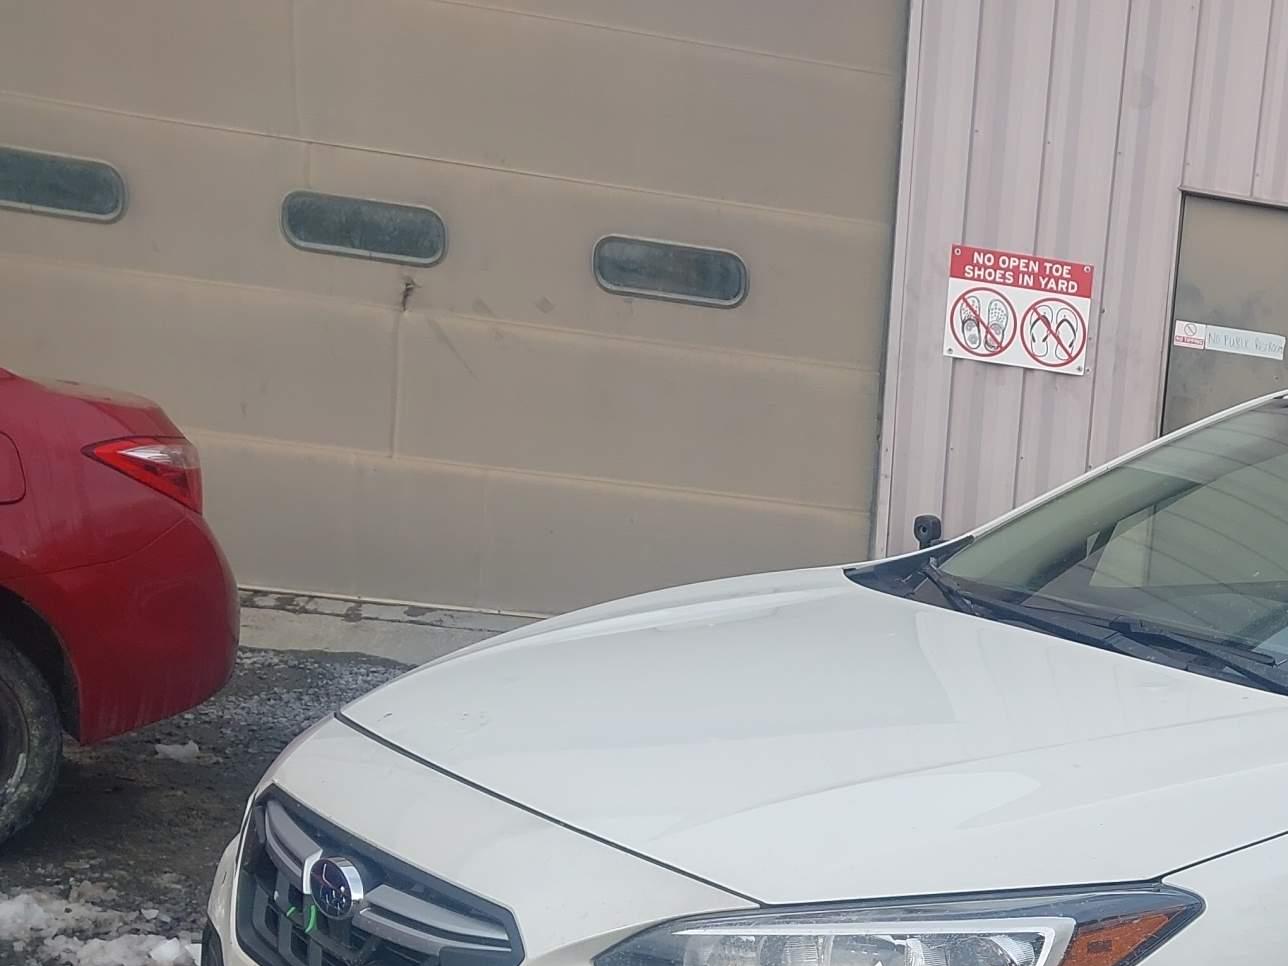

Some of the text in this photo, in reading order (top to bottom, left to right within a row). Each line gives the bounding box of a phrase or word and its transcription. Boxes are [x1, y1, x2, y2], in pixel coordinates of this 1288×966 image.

[973, 251, 1072, 278] NO OPEN TOE
[964, 265, 1078, 293] SHOES IN YARD
